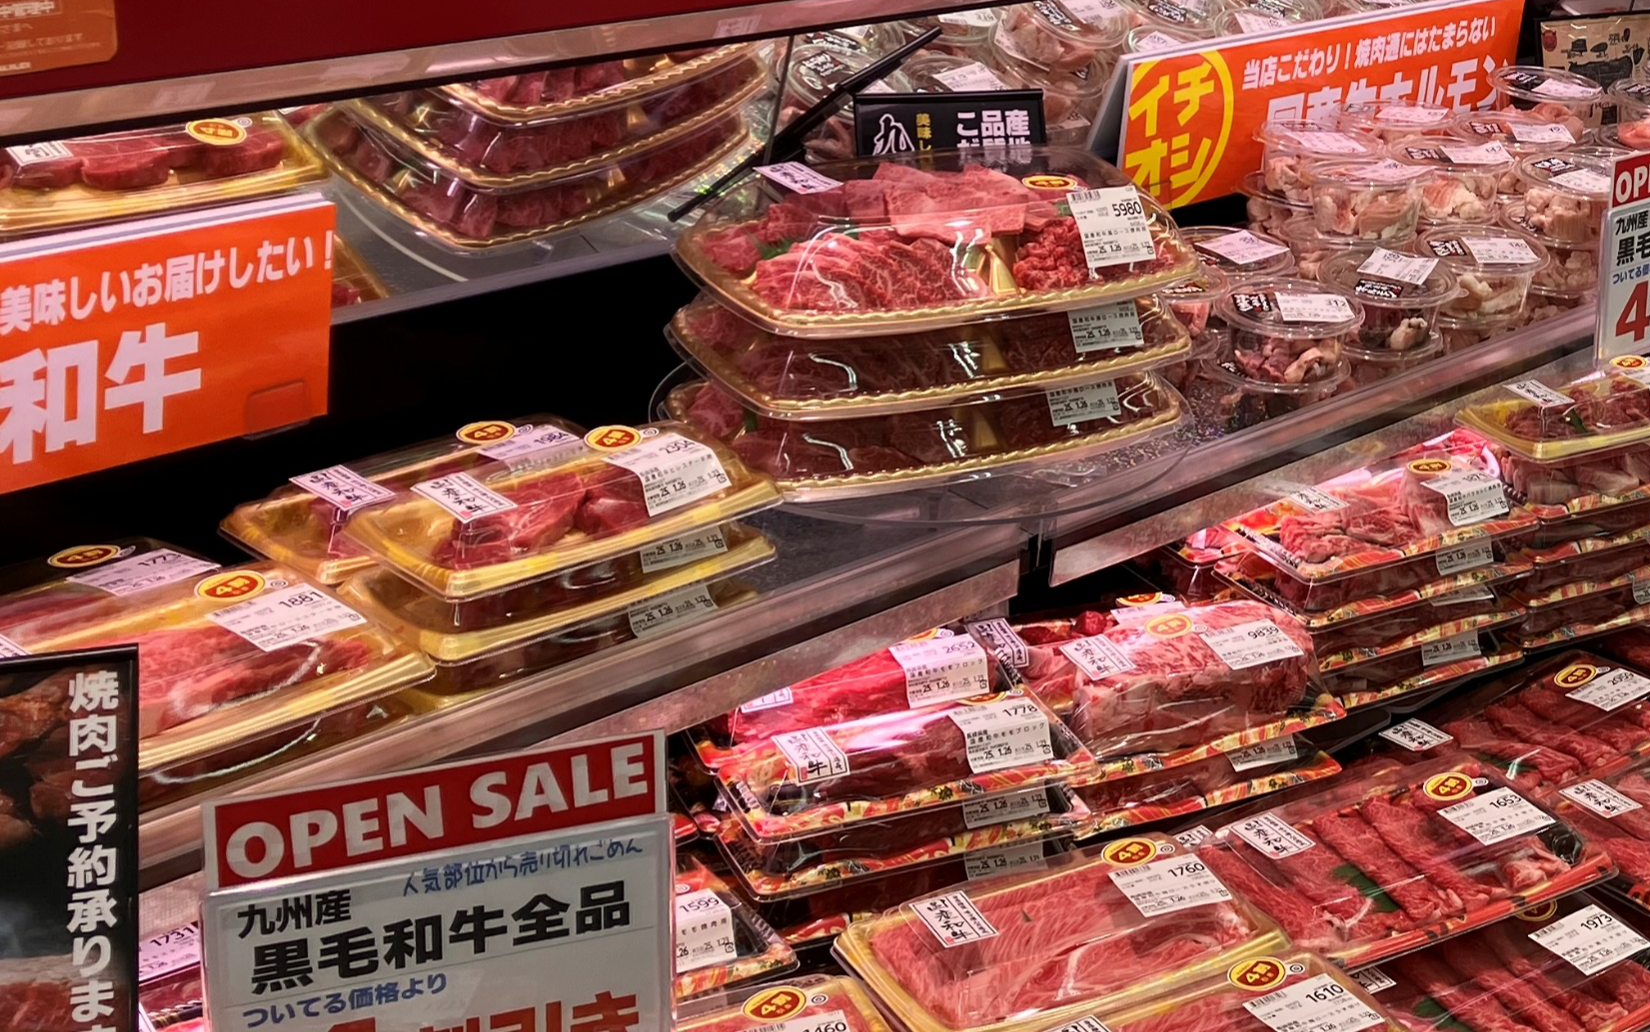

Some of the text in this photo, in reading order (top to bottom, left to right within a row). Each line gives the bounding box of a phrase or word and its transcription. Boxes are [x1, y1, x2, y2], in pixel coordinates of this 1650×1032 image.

[1242, 15, 1497, 91] 当店こだわり!焼肉通にはたまらない
[1128, 61, 1215, 139] イチ
[1111, 201, 1143, 218] 5980
[1615, 210, 1649, 236] 九州産
[0, 230, 335, 335] 美味しいお届けしたい!
[0, 321, 202, 465] 和牛
[278, 590, 325, 610] 1881
[1248, 626, 1279, 639] 9839
[1003, 705, 1038, 717] 1778
[998, 746, 1012, 756] 1.26
[226, 742, 649, 880] OPEN SALE
[1489, 793, 1522, 809] 1653
[66, 670, 120, 1032] 焼肉ご予約承りま
[403, 838, 645, 897] 人気部位から売り切れごめん
[1168, 862, 1205, 877] 1760
[236, 889, 352, 939] 九州産
[679, 897, 719, 913] 1599
[1581, 913, 1613, 930] 1973
[150, 922, 198, 950] 1731
[251, 879, 631, 995] 黒毛和牛全品
[242, 973, 448, 1028] ついてる価格より
[1305, 983, 1344, 1003] 1610
